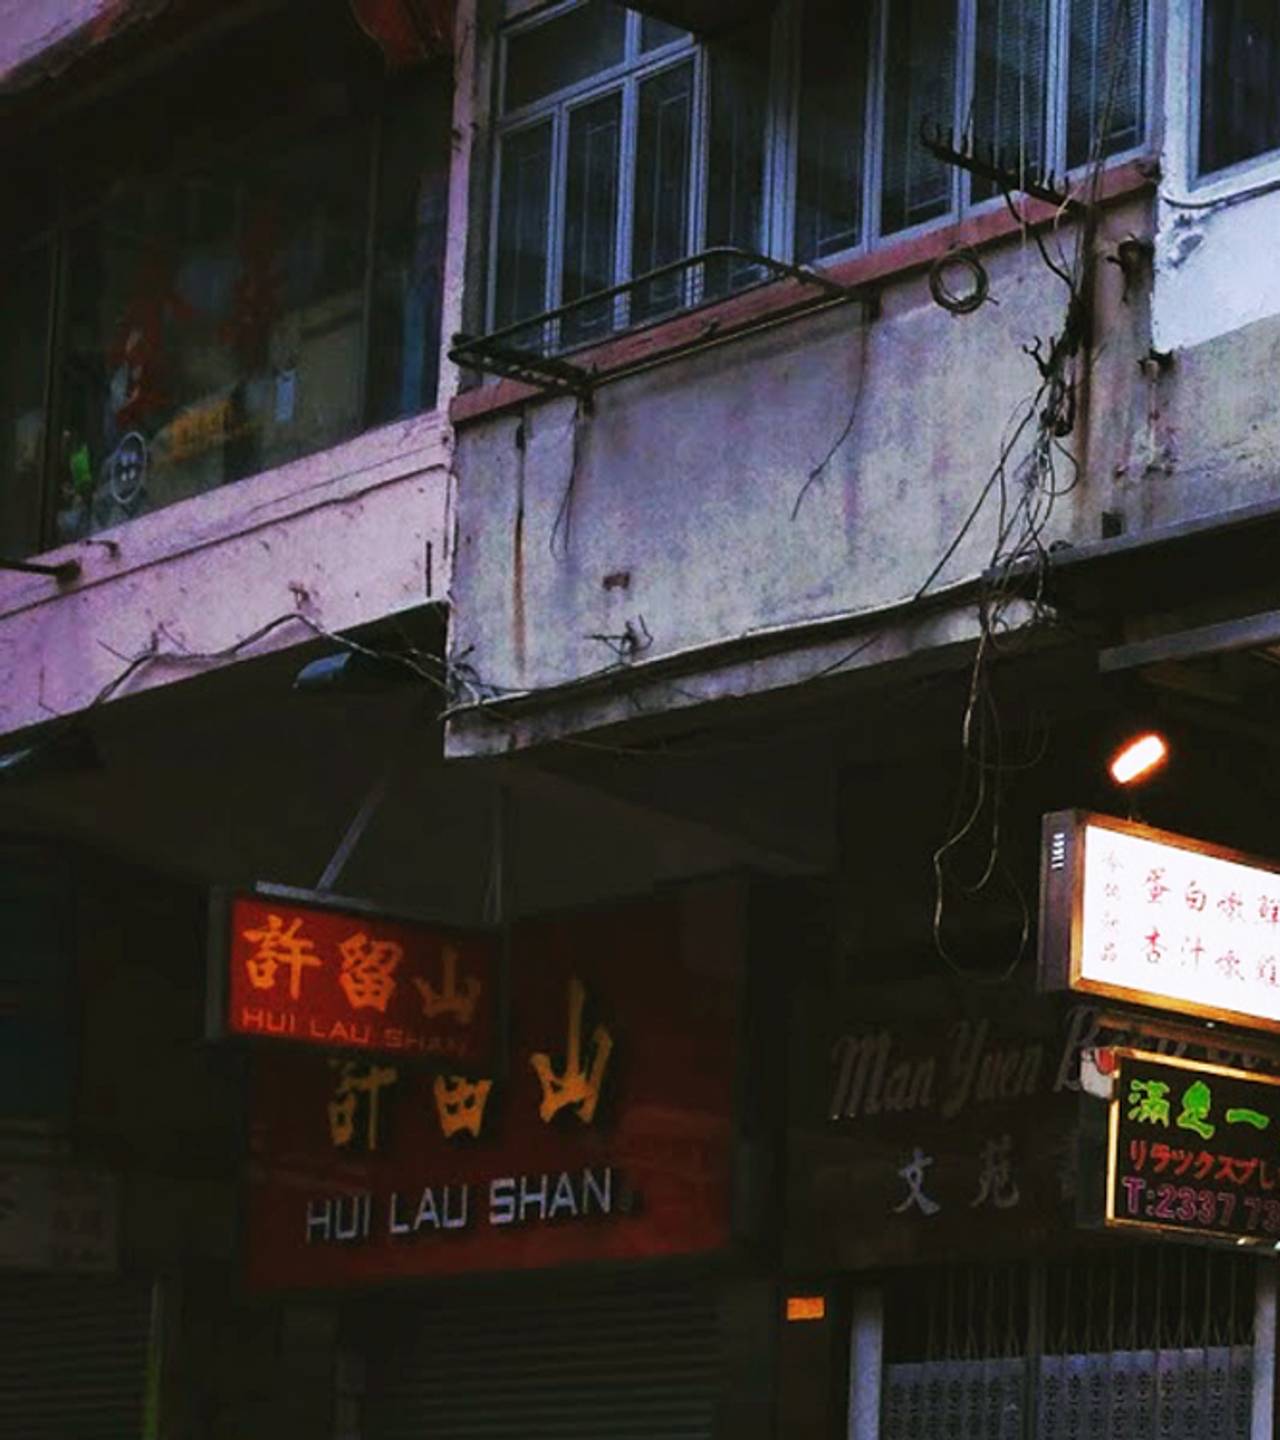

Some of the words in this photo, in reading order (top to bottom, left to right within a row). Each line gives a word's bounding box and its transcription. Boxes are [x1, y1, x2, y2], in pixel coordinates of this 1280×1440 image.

[242, 914, 481, 1025] 許留山
[242, 1007, 296, 1034] HUI
[309, 1017, 370, 1046] LAU
[384, 1027, 468, 1056] SHAN
[831, 1031, 936, 1120] Man
[306, 1194, 371, 1245] HUI
[389, 1186, 468, 1236] LAU
[489, 1167, 613, 1227] SHAN
